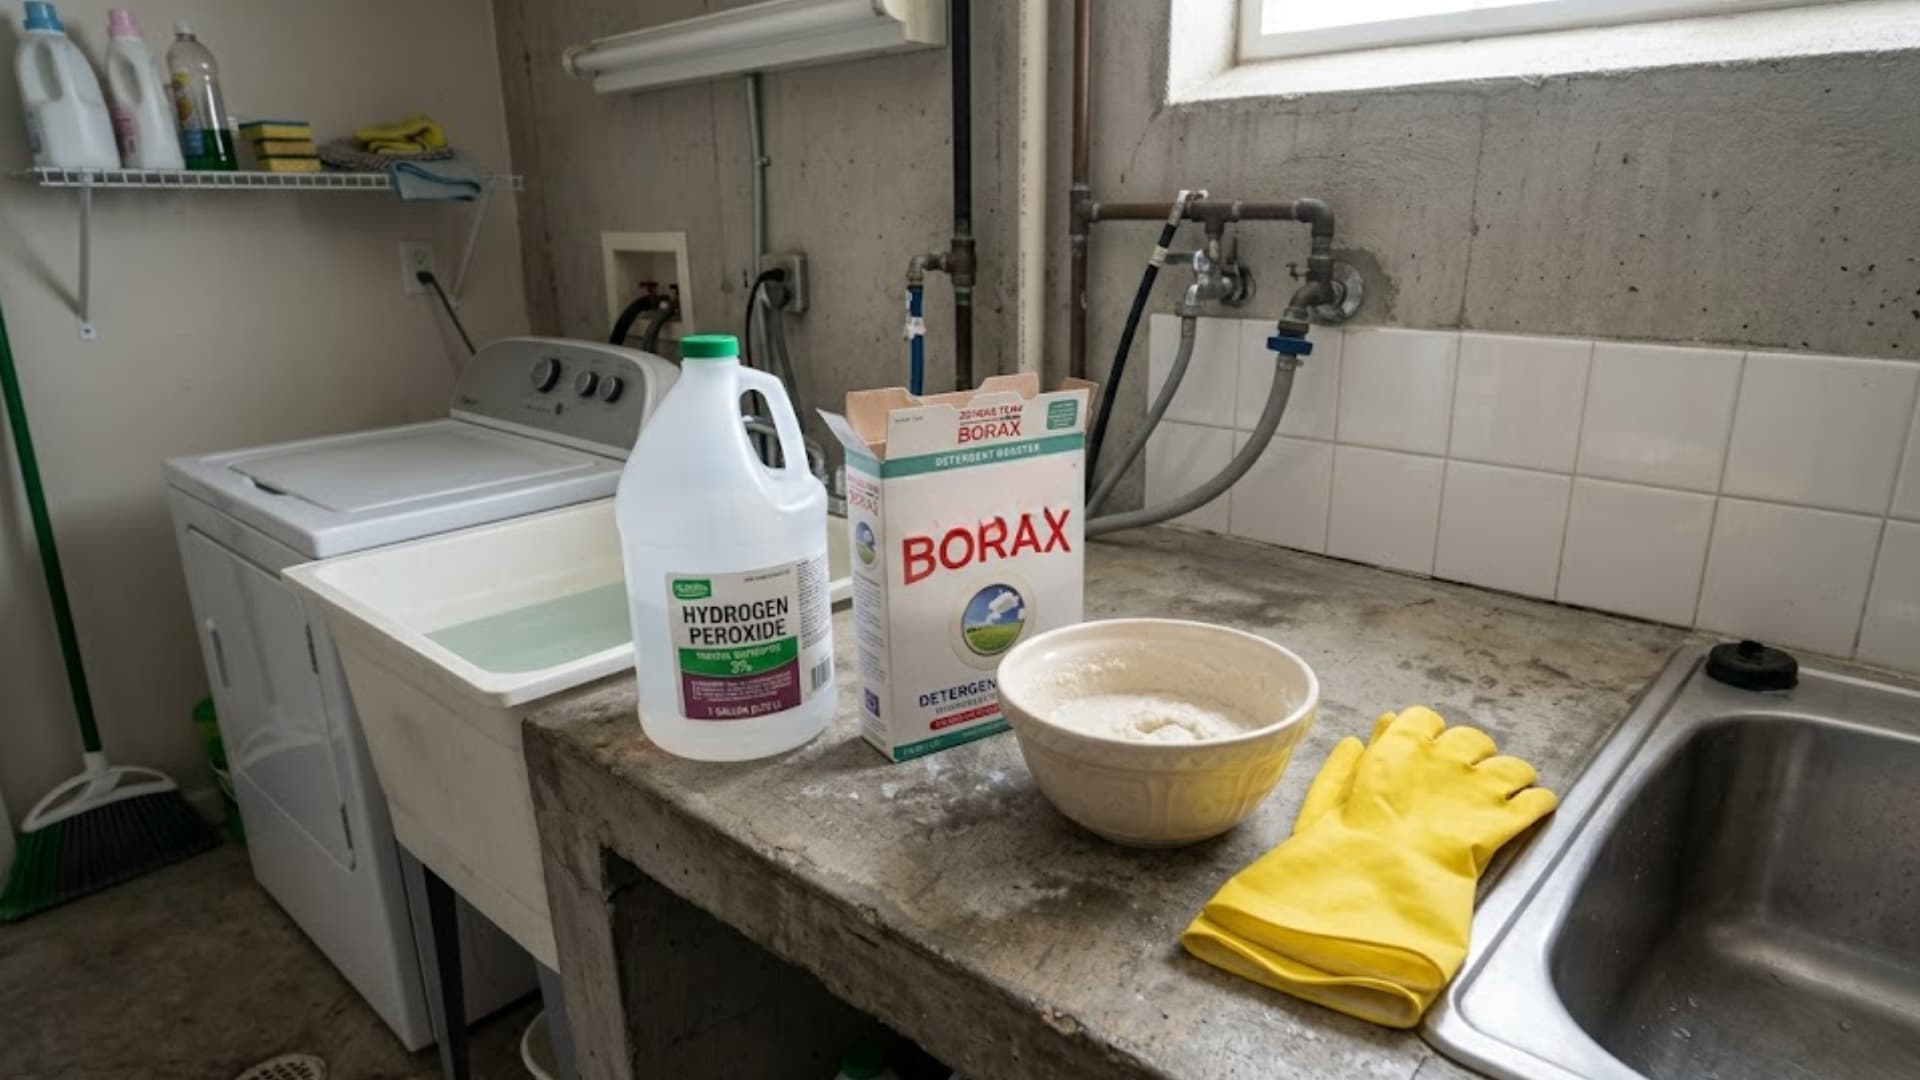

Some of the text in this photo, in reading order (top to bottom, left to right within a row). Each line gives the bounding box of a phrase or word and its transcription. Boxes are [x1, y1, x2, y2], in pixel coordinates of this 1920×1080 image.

[958, 421, 1021, 444] BORAX
[902, 507, 1072, 586] BORAX
[682, 595, 789, 624] HYDROGEN
[689, 618, 787, 645] PEROXIDE
[730, 660, 753, 674] 3%
[919, 679, 997, 708] DETERGEN
